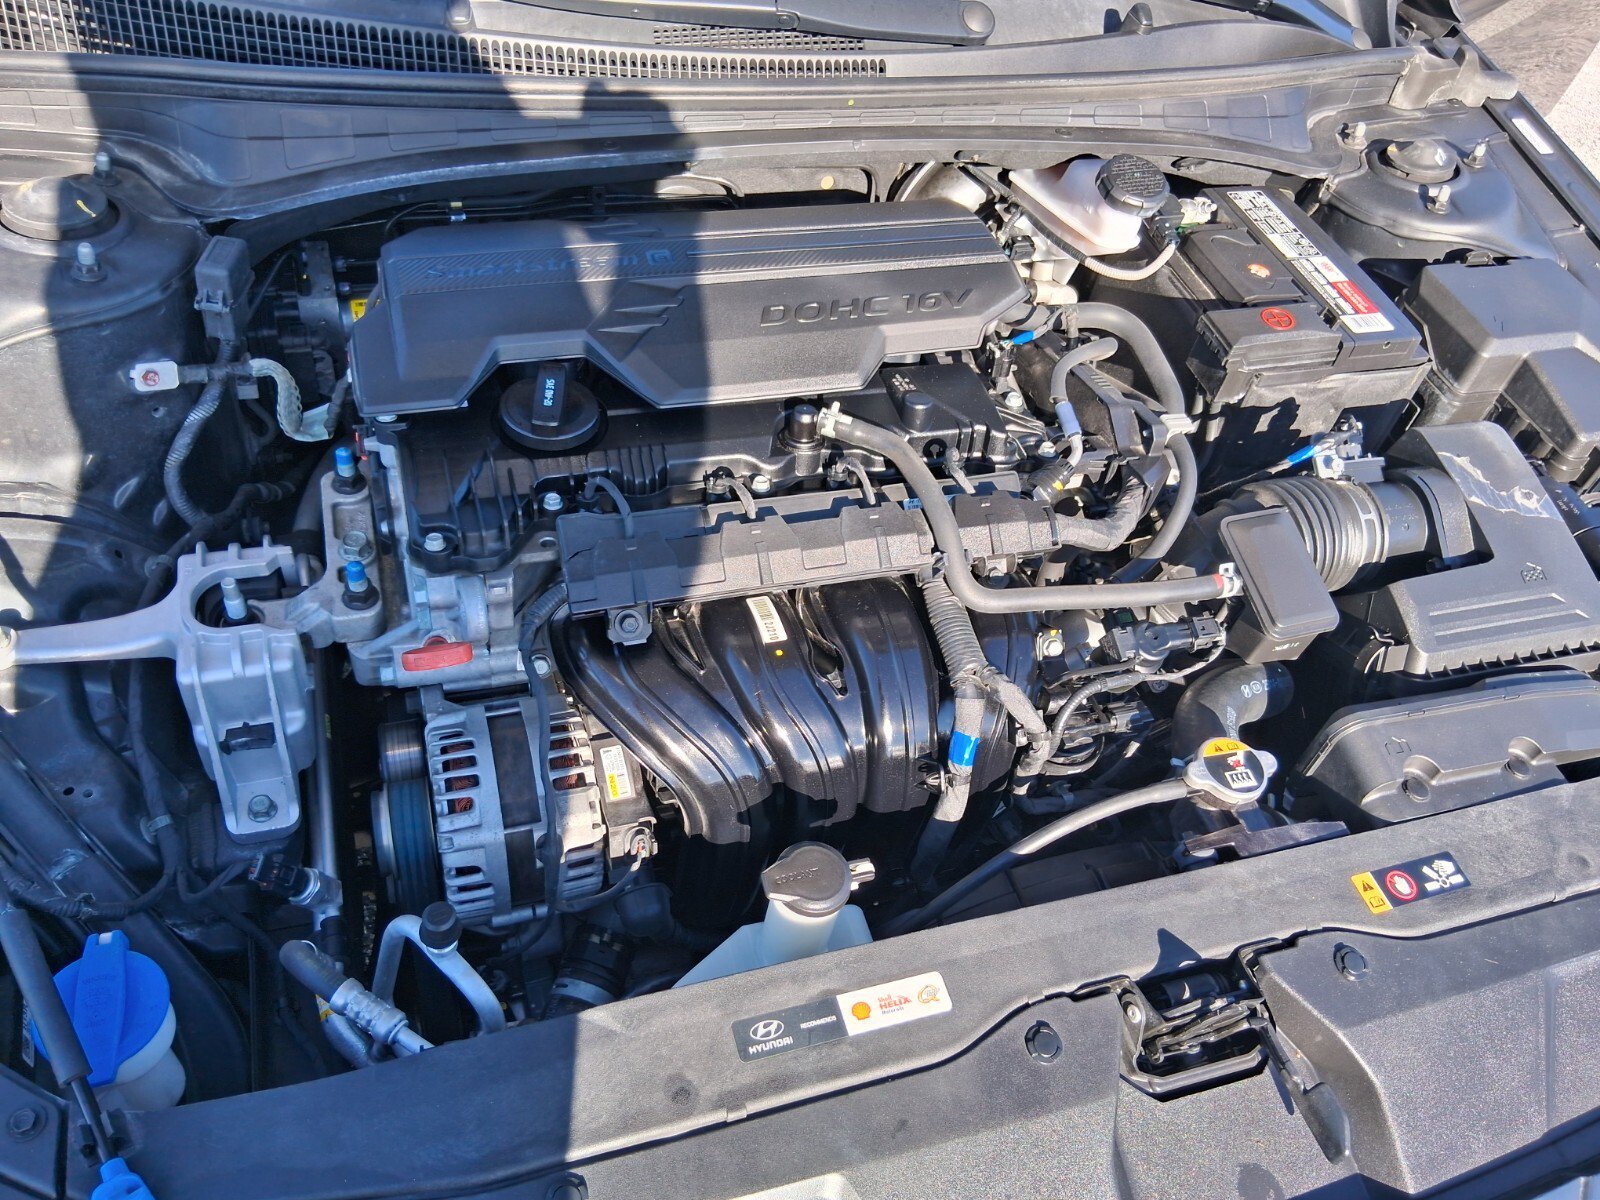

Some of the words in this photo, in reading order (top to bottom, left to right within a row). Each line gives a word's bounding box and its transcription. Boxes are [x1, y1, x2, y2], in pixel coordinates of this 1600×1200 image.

[760, 296, 891, 327] DOHC
[902, 288, 975, 314] 16V
[545, 378, 555, 390] SAE
[879, 996, 913, 1011] HELIX
[748, 1035, 794, 1055] HYUNDAI
